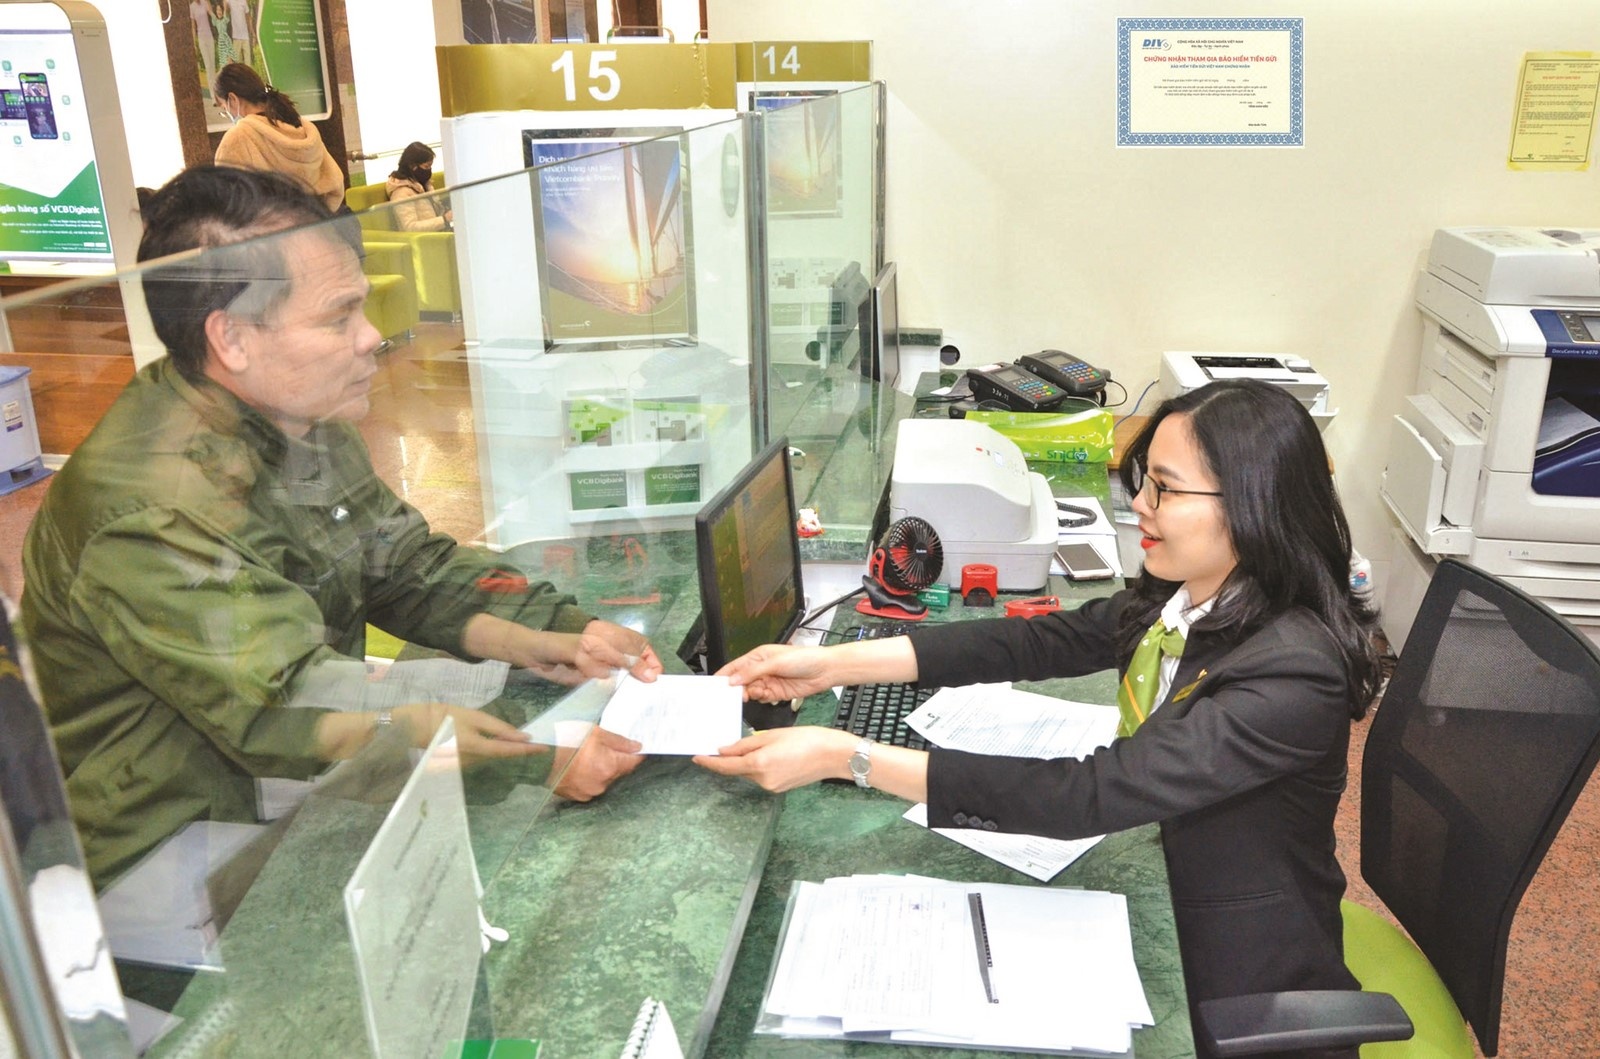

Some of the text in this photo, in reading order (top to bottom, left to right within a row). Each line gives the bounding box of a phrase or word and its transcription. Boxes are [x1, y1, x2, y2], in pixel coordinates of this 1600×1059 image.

[762, 45, 801, 75] 14
[1168, 55, 1186, 63] NHẬN
[1232, 54, 1249, 62] HIỂM
[551, 50, 621, 102] 15
[0, 204, 16, 214] gân
[17, 205, 38, 214] hàng
[40, 204, 50, 213] số
